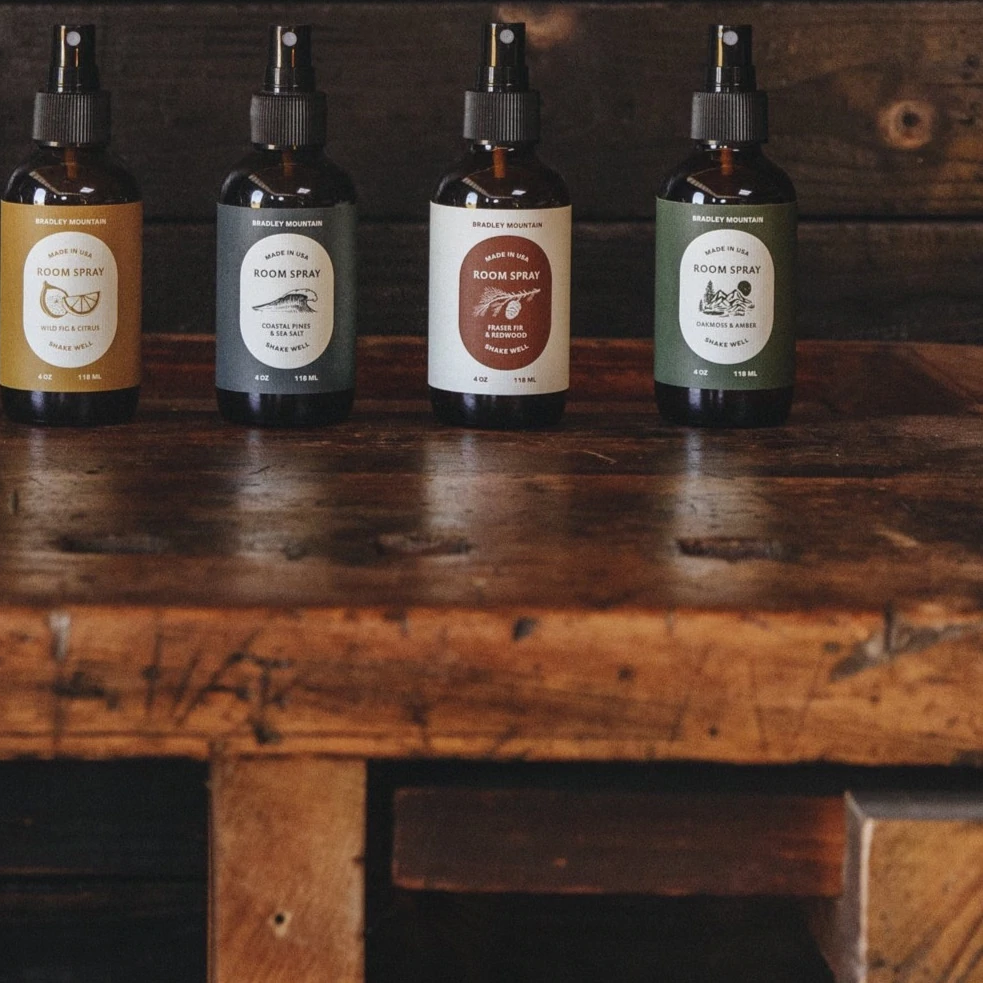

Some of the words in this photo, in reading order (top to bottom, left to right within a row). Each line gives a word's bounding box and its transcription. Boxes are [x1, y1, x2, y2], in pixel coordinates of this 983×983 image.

[48, 249, 68, 258] MADE
[79, 250, 92, 258] USA
[265, 250, 285, 260] MADE
[296, 251, 309, 260] USA
[705, 246, 725, 256] MADE
[736, 248, 749, 256] USA
[485, 252, 506, 262] MADE
[516, 253, 529, 262] USA
[37, 267, 70, 276] ROOM
[73, 267, 105, 276] SPRAY
[254, 269, 287, 278] ROOM
[290, 269, 321, 278] SPRAY
[693, 264, 727, 273] ROOM
[730, 265, 761, 274] SPRAY
[473, 270, 507, 280] ROOM
[510, 271, 540, 280] SPRAY
[49, 341, 72, 351] SHAKE
[74, 341, 93, 351] WELL
[266, 342, 288, 352] SHAKE
[291, 342, 310, 352] WELL
[705, 337, 728, 347] SHAKE
[730, 338, 749, 347] WELL
[484, 344, 508, 354] SHAKE
[510, 344, 529, 354] WELL
